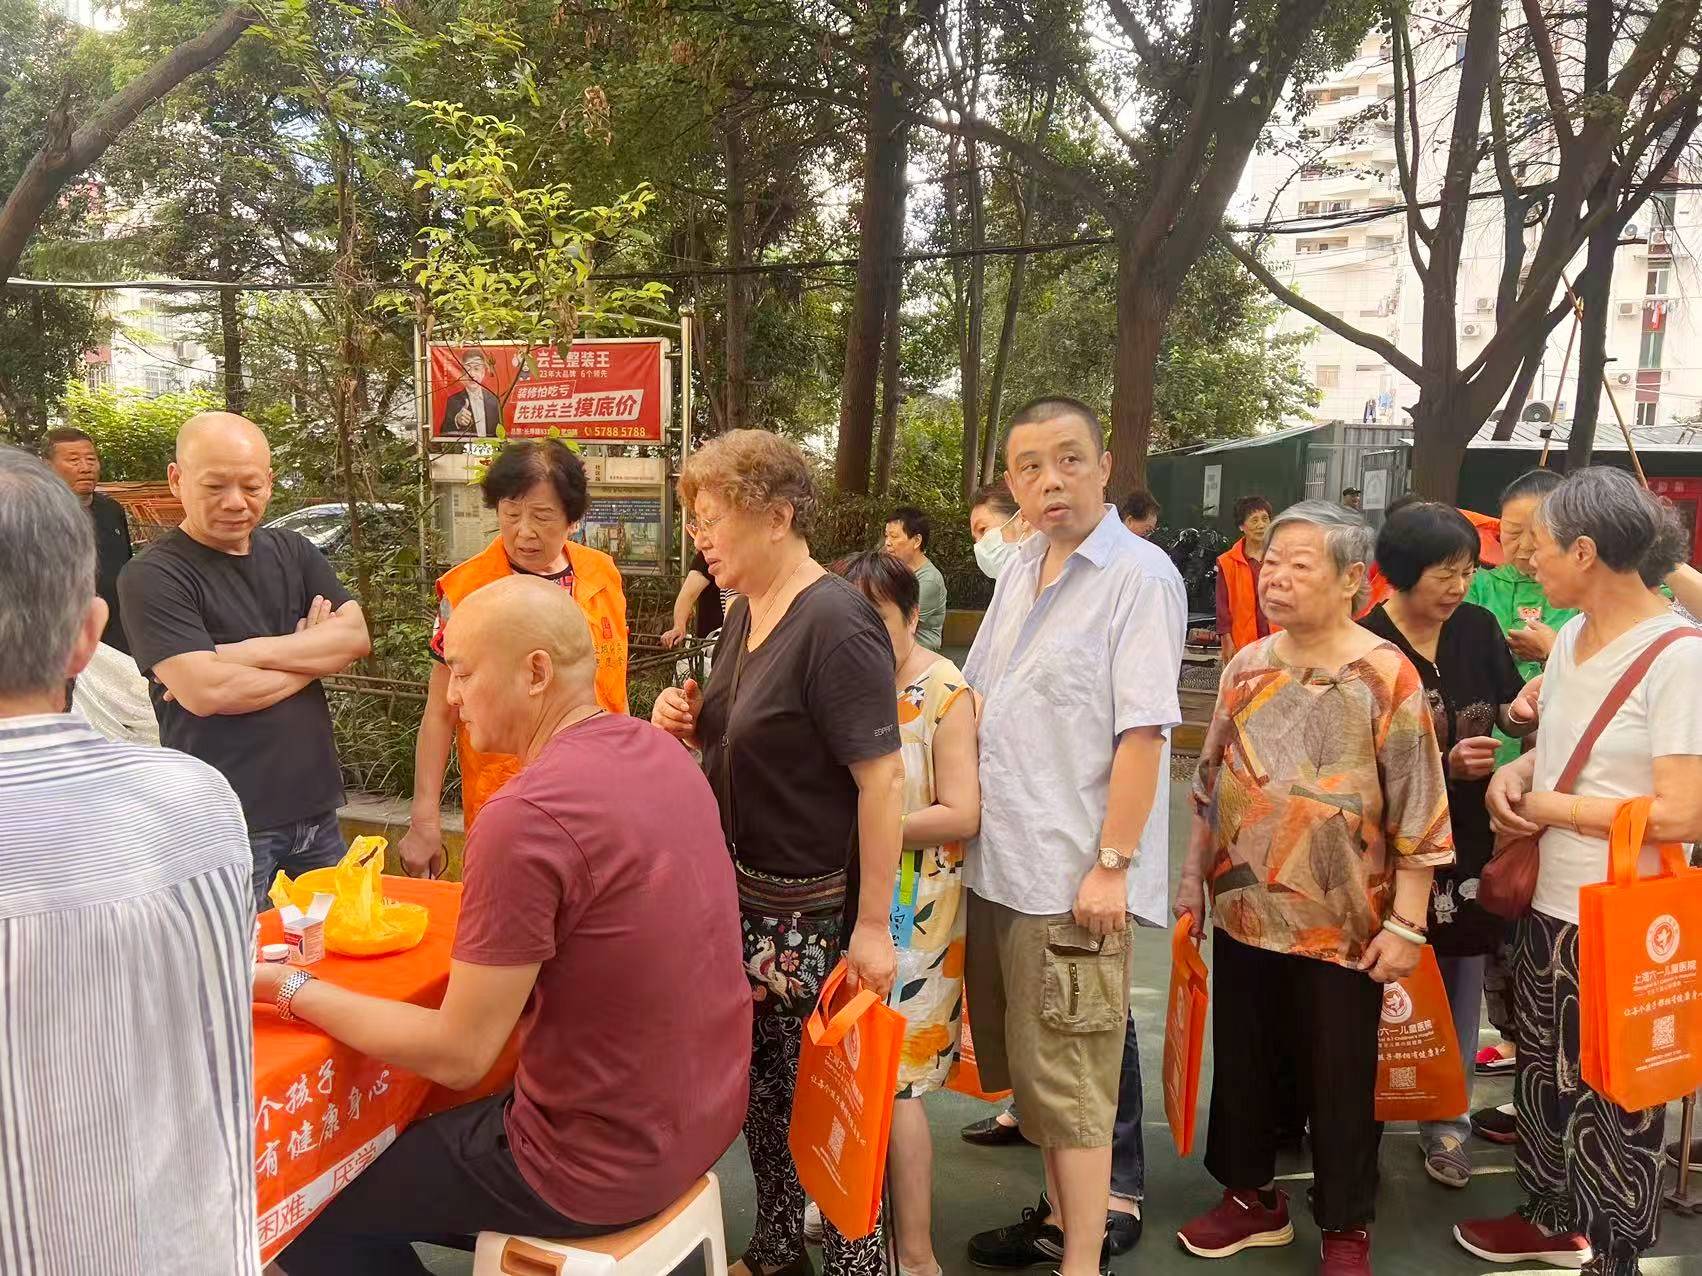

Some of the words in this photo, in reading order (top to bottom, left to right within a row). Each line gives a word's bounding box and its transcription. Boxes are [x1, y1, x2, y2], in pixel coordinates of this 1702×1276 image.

[537, 350, 610, 368] 云兰整装王
[581, 369, 608, 378] 6个领先
[517, 384, 570, 399] 装修怕吃亏
[517, 394, 637, 420] 先找云兰摸底价
[594, 427, 619, 437] 5788
[621, 427, 646, 437] 5788
[1633, 959, 1697, 985] 上海六一儿童医院
[1377, 1019, 1433, 1036] 六一儿童医院
[254, 1058, 336, 1131] 个孩子
